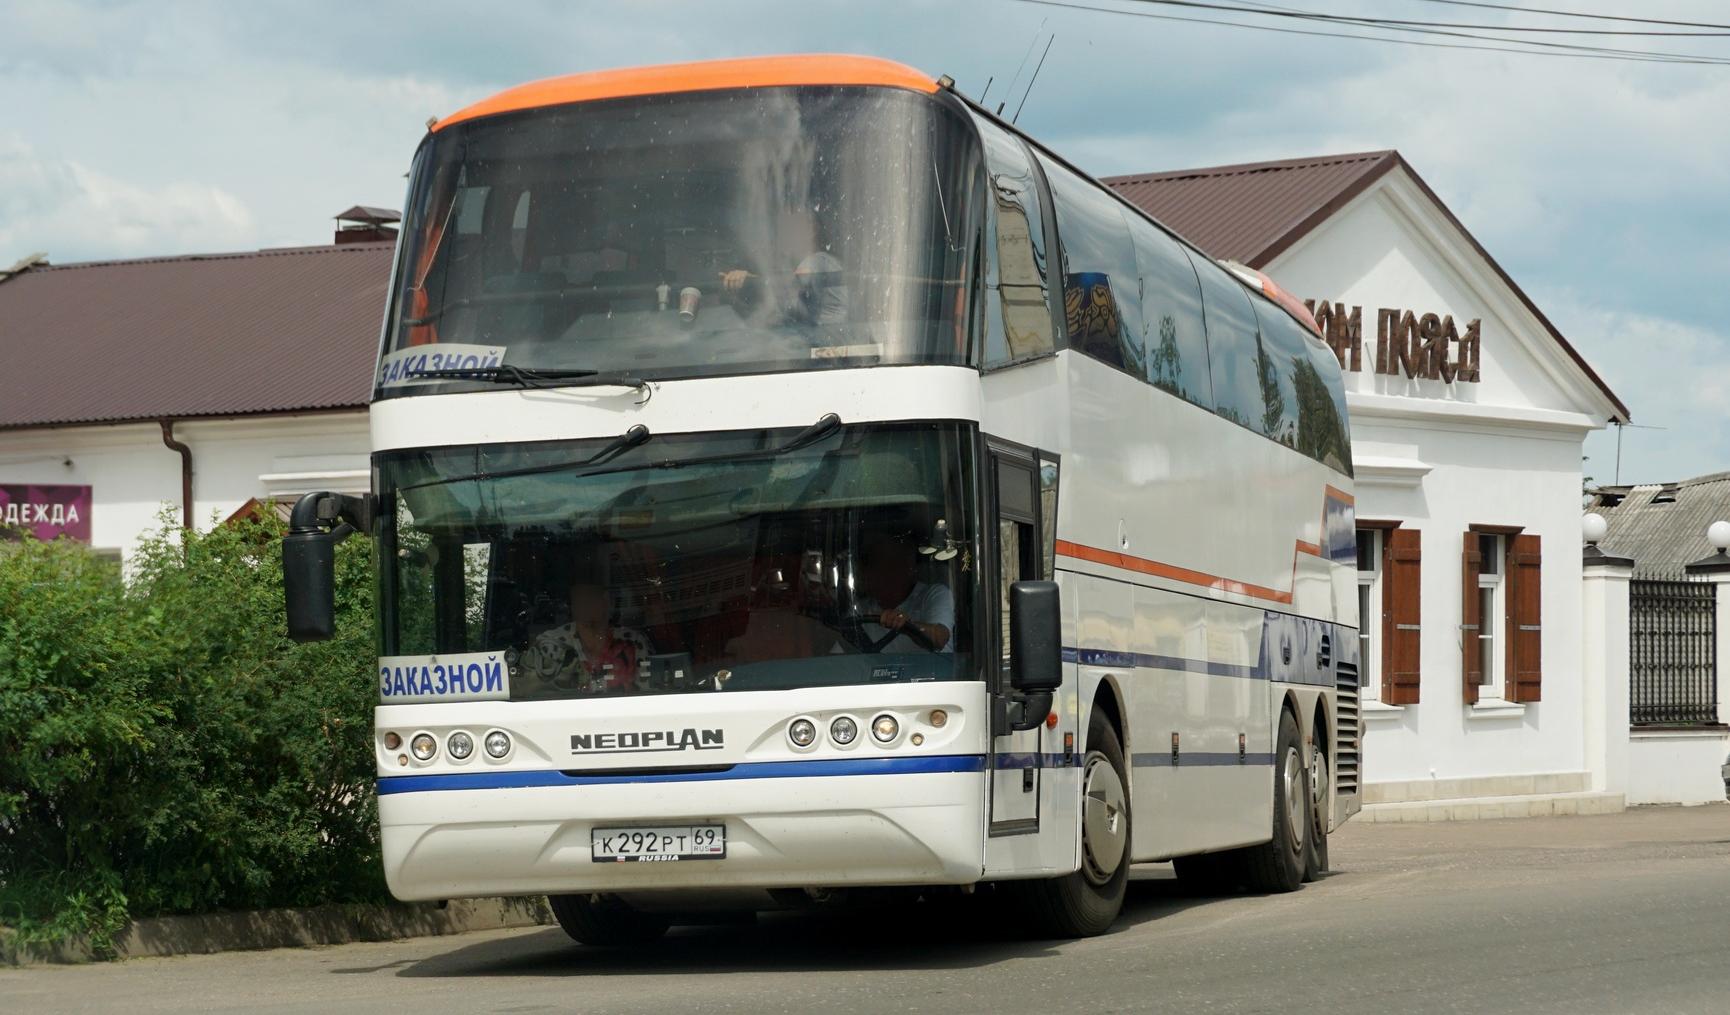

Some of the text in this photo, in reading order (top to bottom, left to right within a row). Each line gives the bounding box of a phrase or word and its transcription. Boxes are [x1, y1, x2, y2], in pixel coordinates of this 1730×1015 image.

[1304, 298, 1362, 372] ОМ
[0, 503, 80, 526] ДЕЖДА
[381, 655, 503, 696] ЗАКАЗНОЙ
[571, 728, 724, 751] NEOPLAN
[694, 829, 715, 845] 69
[638, 854, 680, 862] RUSSIA
